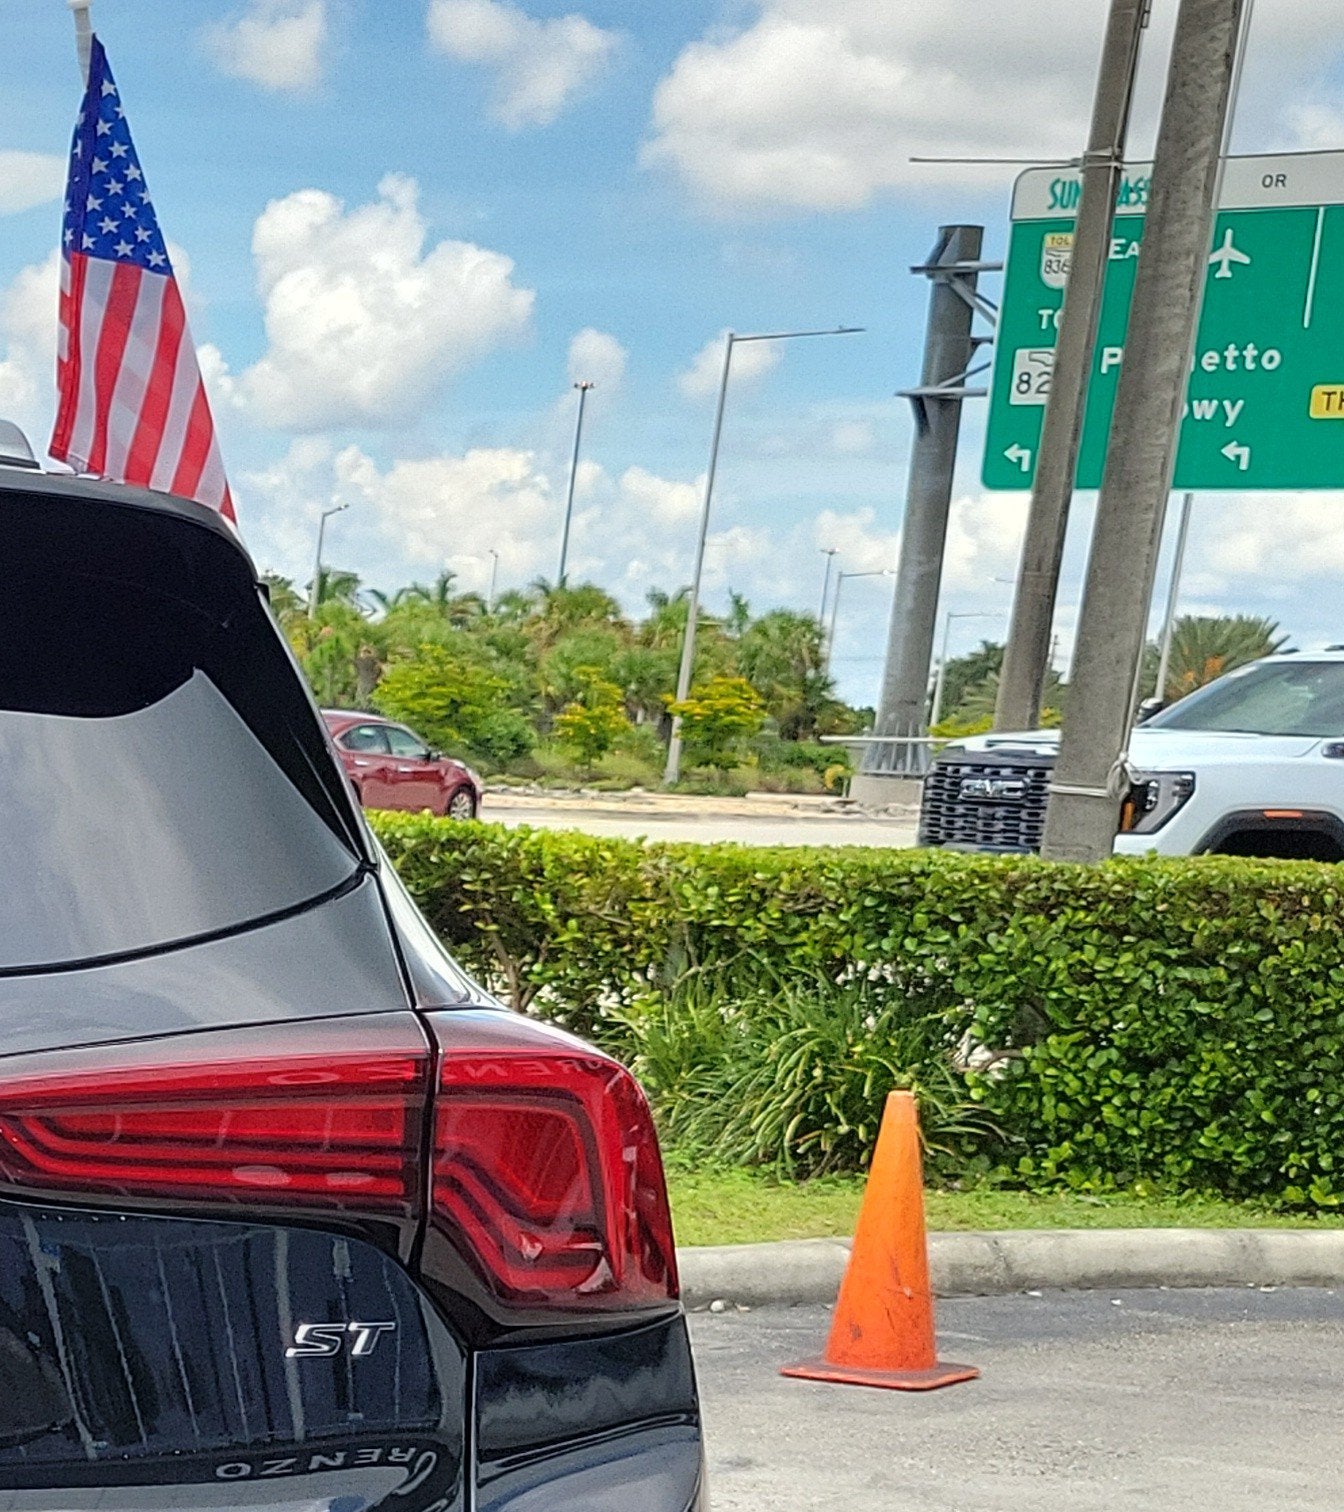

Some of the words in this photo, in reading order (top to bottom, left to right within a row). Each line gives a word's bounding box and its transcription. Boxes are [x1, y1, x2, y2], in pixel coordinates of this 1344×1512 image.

[1261, 174, 1287, 188] OR
[1109, 239, 1140, 260] EA
[1101, 342, 1282, 374] Petto
[1016, 371, 1051, 394] 82
[285, 1321, 396, 1358] ST
